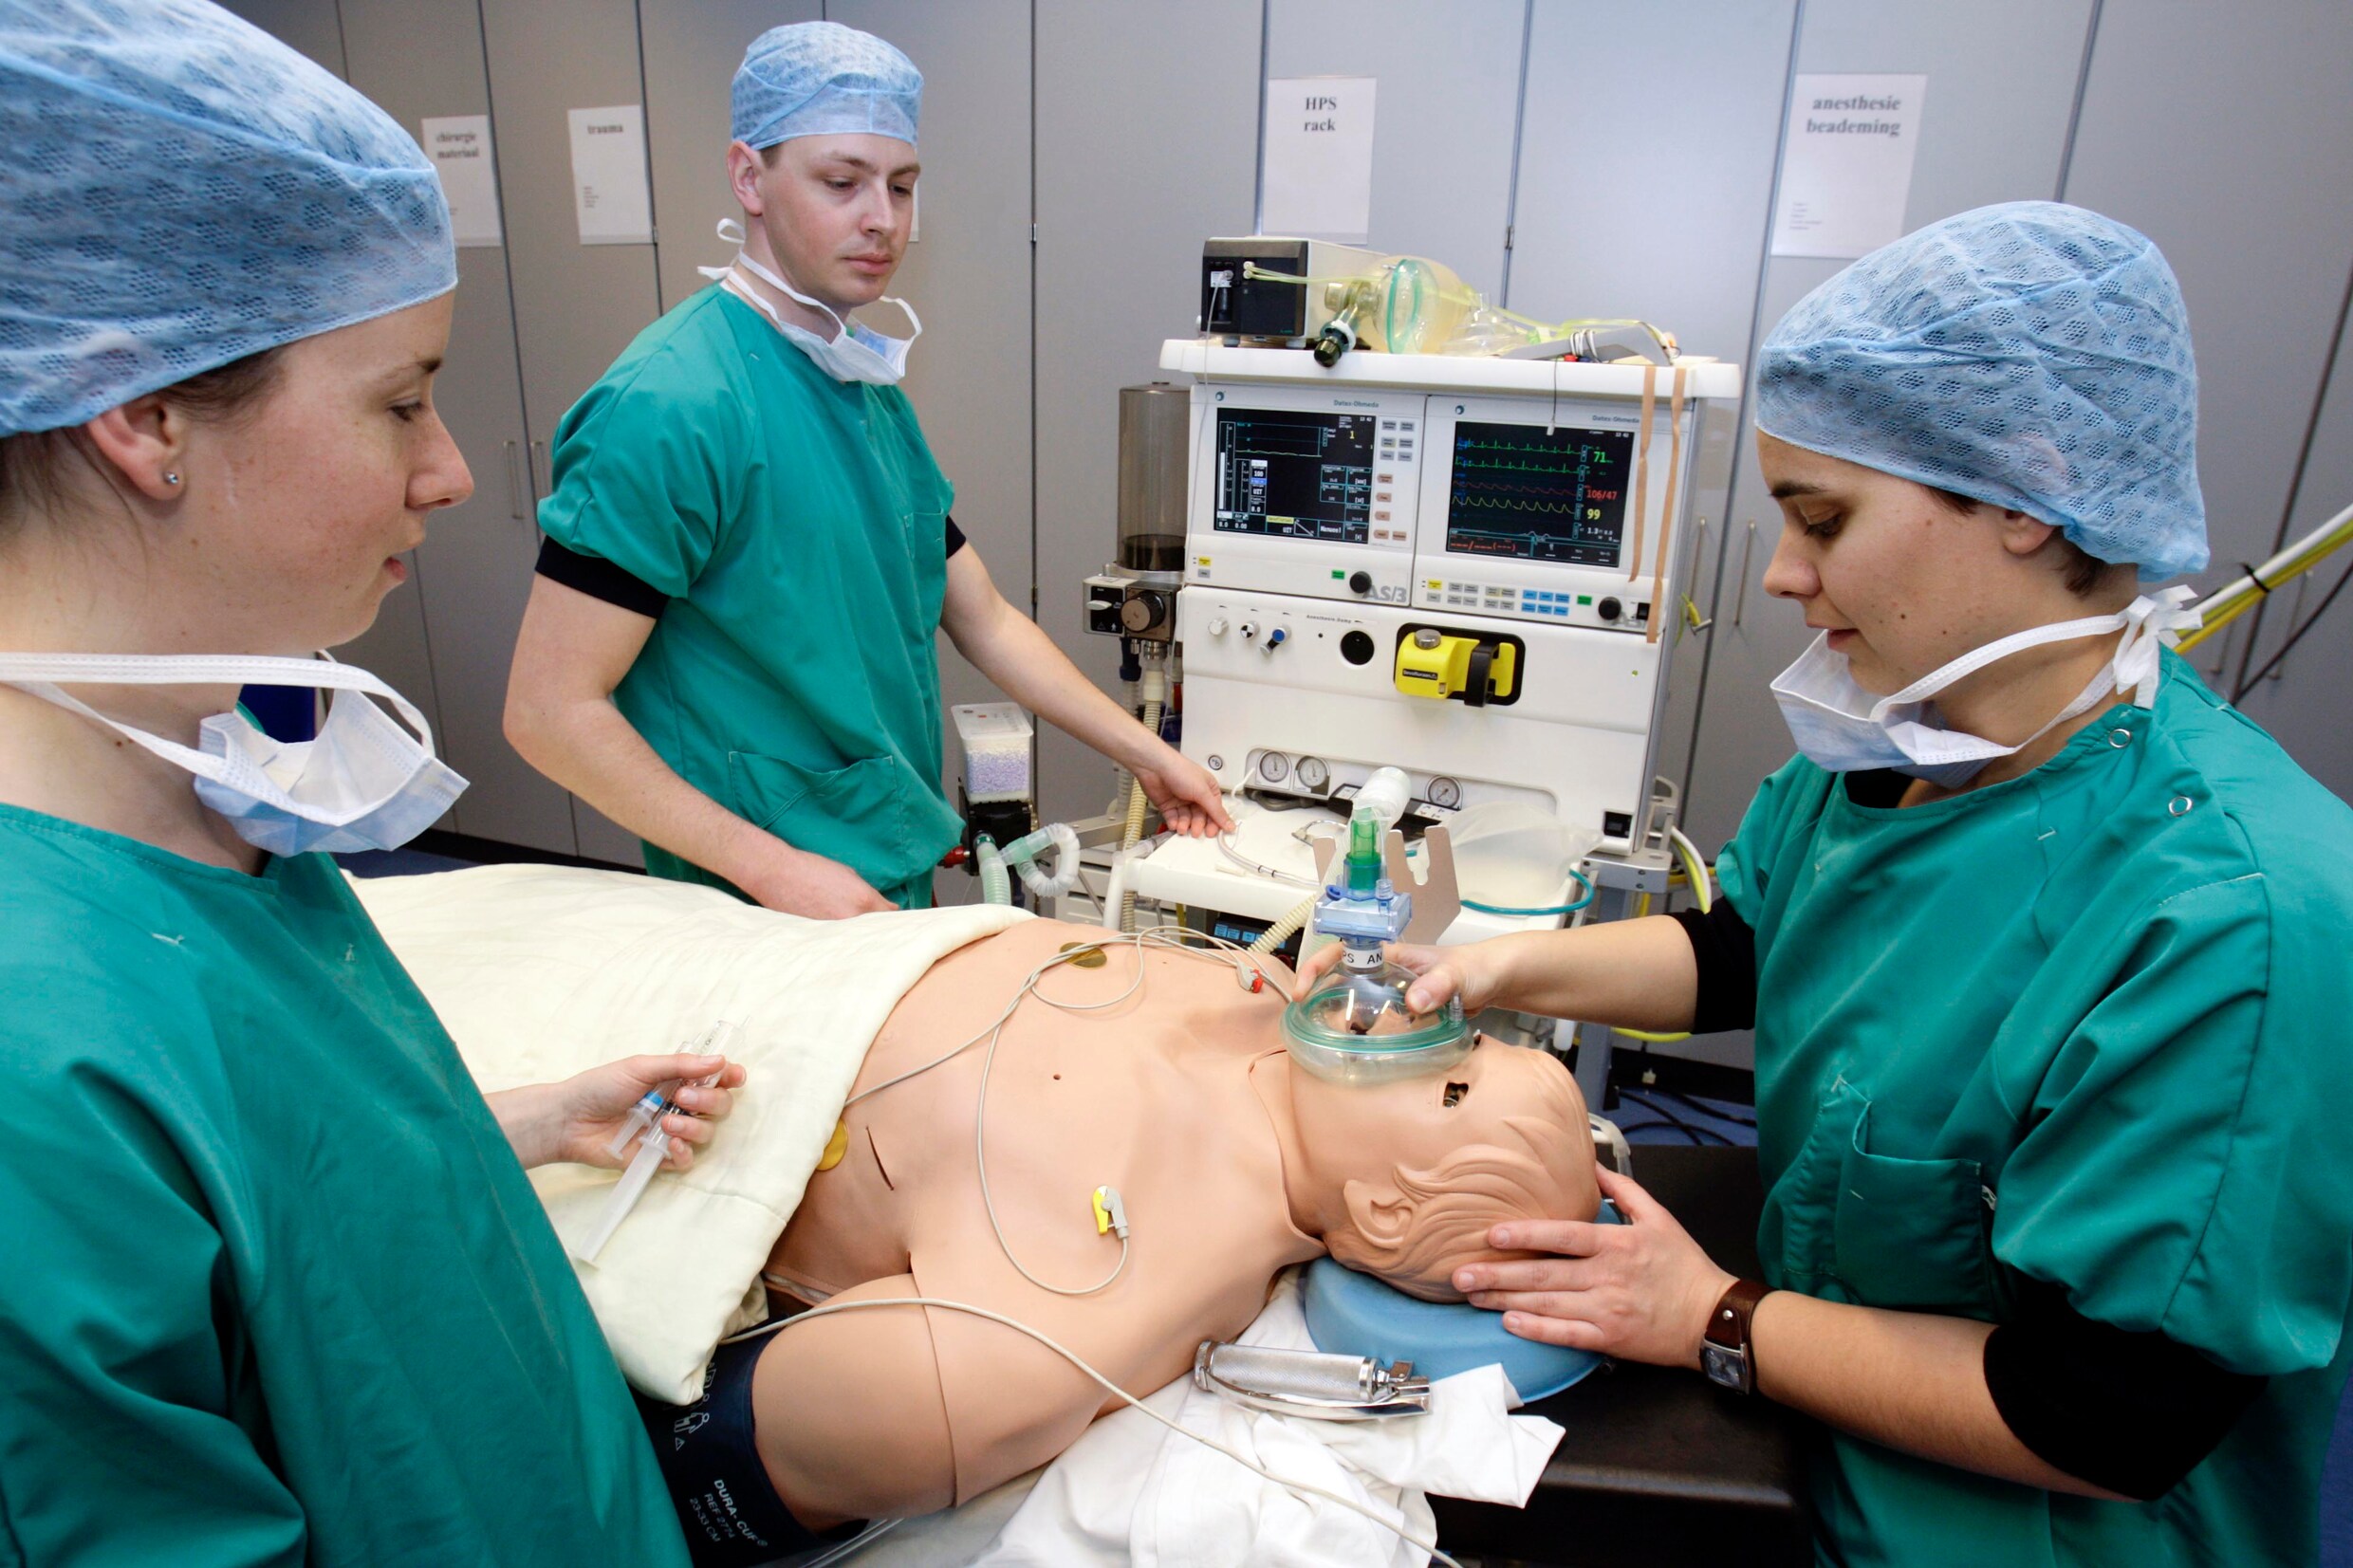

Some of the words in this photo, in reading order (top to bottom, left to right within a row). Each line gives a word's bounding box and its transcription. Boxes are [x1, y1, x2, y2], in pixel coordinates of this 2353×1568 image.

[1306, 97, 1337, 110] HPS
[1812, 95, 1900, 111] anesthesie
[587, 124, 623, 135] trauma
[1304, 118, 1336, 132] rack
[1806, 119, 1900, 138] beademing
[1594, 451, 1606, 463] 71
[1586, 508, 1602, 520] 99
[1362, 584, 1408, 603] AS/3
[703, 1493, 722, 1515] REF
